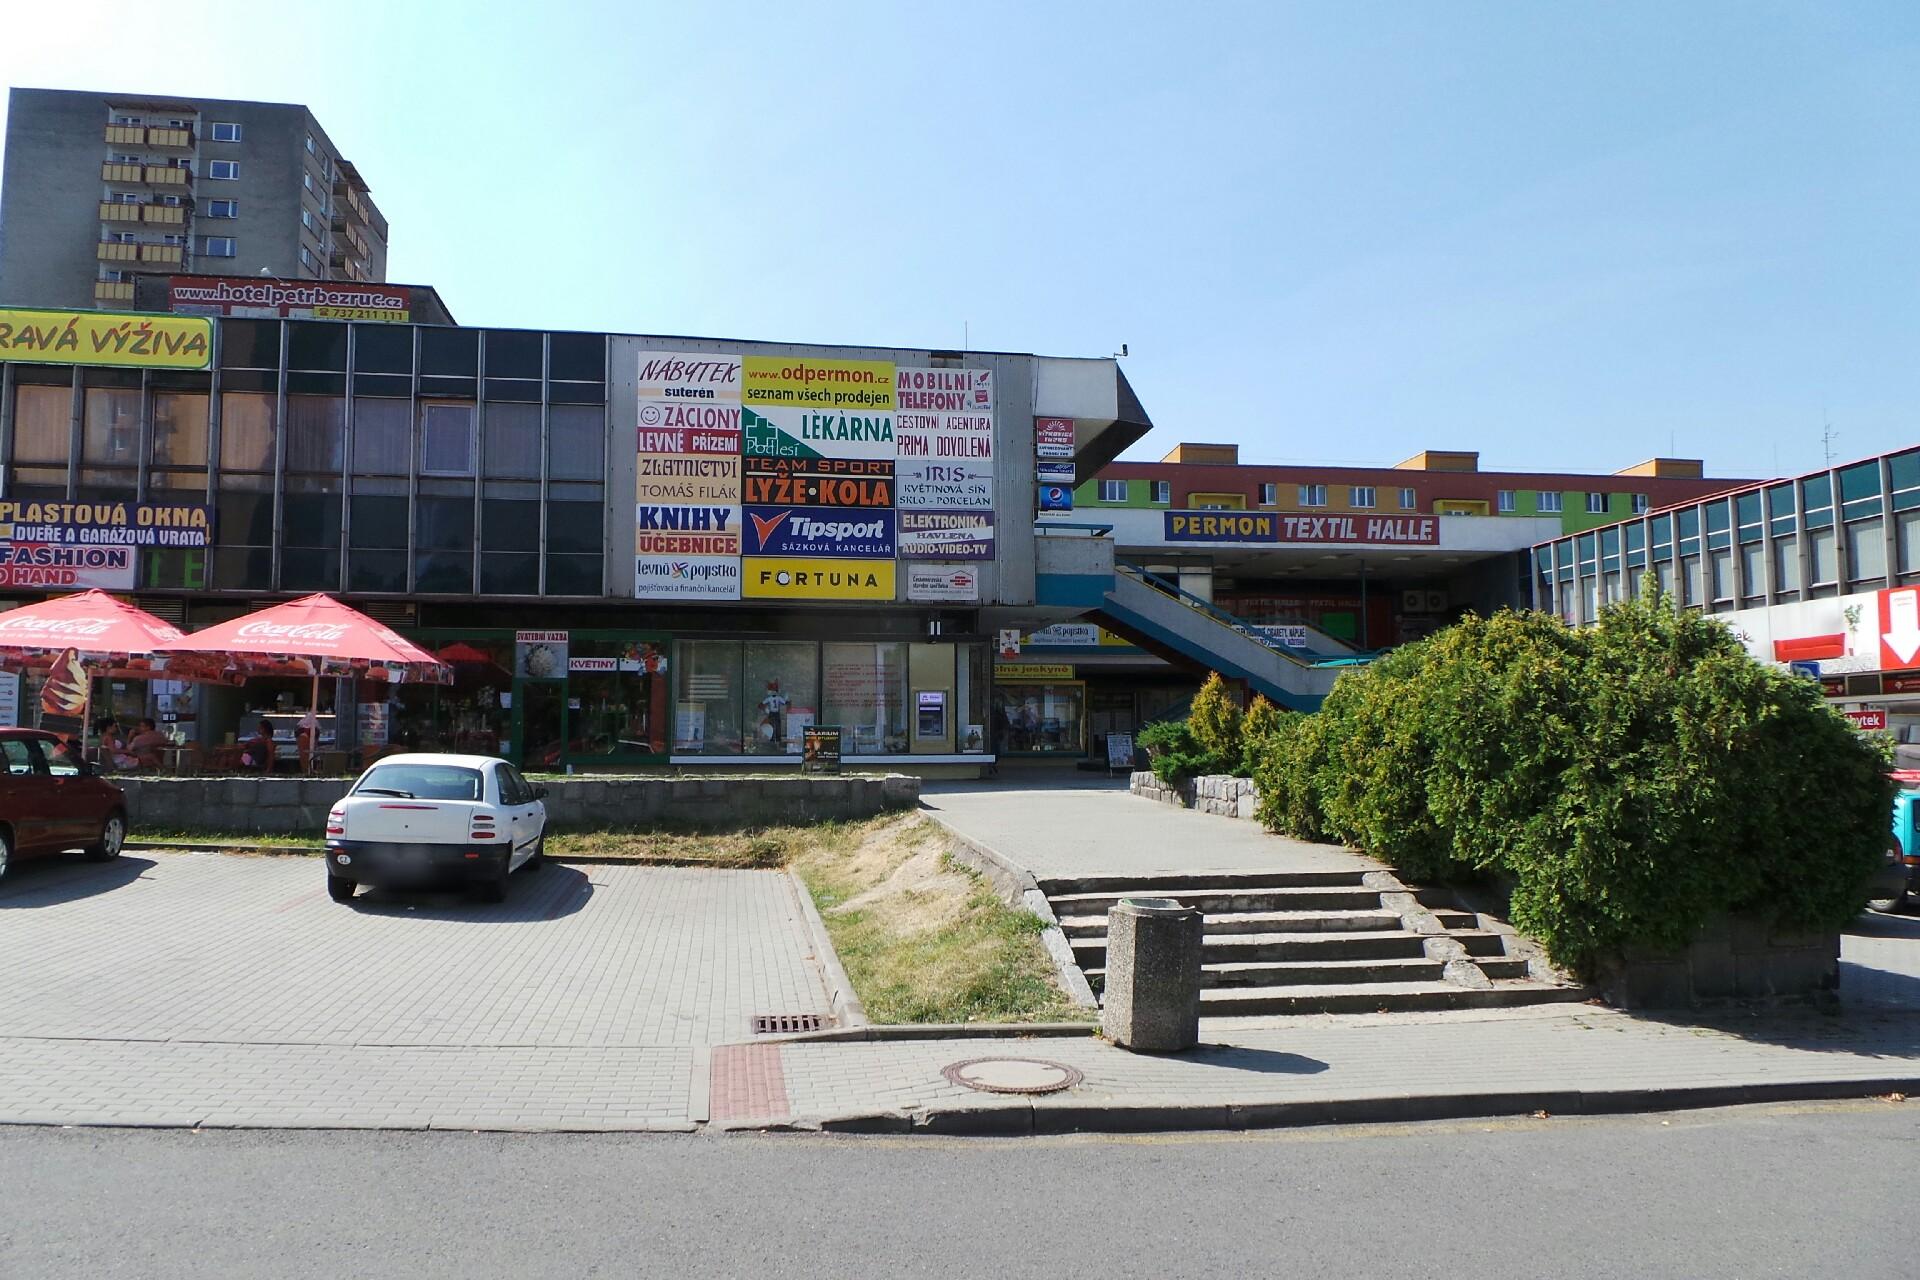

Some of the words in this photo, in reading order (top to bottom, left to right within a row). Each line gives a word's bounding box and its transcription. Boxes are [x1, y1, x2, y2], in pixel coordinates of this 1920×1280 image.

[175, 283, 403, 308] www.hotelpetrbezruc.cz
[332, 308, 352, 318] 737
[356, 309, 379, 319] 211
[383, 310, 403, 321] 111
[91, 322, 207, 357] VÝŽIVA
[640, 356, 741, 383] NÁBYTEK
[748, 363, 889, 384] www.odpermon.cz
[898, 370, 972, 390] MOBILNÍ
[665, 387, 714, 398] suterén
[747, 388, 794, 400] seznam
[797, 388, 831, 401] všech
[835, 390, 890, 406] prodejen
[898, 391, 966, 410] TELEFONY
[664, 402, 741, 429] ZÁCLONY
[897, 413, 940, 429] CESTOVNÍ
[946, 417, 991, 430] AGENTURA
[640, 429, 684, 452] LEVNÉ
[692, 433, 738, 452] PŘÍZEMÍ
[746, 439, 800, 457] Podlesí
[897, 435, 928, 456] PRIMA
[937, 435, 991, 458] DOVOLENÁ
[641, 457, 737, 478] ZLATNICTVÍ
[746, 458, 807, 471] TEAM
[818, 460, 894, 473] SPORT
[926, 466, 965, 482] IRIS
[641, 483, 694, 498] TOMÁŠ
[700, 484, 737, 499] FILÁK
[745, 472, 807, 503] LYŽE
[819, 480, 890, 506] KOLA
[900, 496, 926, 505] SKLO
[0, 503, 128, 526] PLASTOVÁ
[137, 506, 206, 528] OKNA
[640, 507, 731, 531] KNIHY
[903, 514, 987, 529] ELEKTRONIKA
[16, 524, 61, 542] DVEŘE
[65, 527, 75, 542] A
[79, 525, 155, 545] GARÁŽOVÁ
[159, 531, 205, 546] VRATA
[790, 517, 884, 541] Tipsport
[916, 532, 975, 540] HAVLENA
[1172, 516, 1271, 536] PERMON
[1284, 517, 1357, 539] TEXTIL
[1368, 519, 1433, 541] HALLE
[640, 533, 737, 554] UČEBNICE
[781, 543, 830, 551] SÁZKOVÁ
[836, 544, 891, 553] KANCELÁŘ
[902, 543, 987, 555] AUDIO-VIDEO-TV
[0, 547, 128, 568] FASHION
[13, 568, 78, 586] HAND
[637, 560, 670, 576] levná
[690, 564, 737, 580] pojistka
[760, 570, 878, 587] FORTUNA
[1844, 714, 1880, 726] bytek
